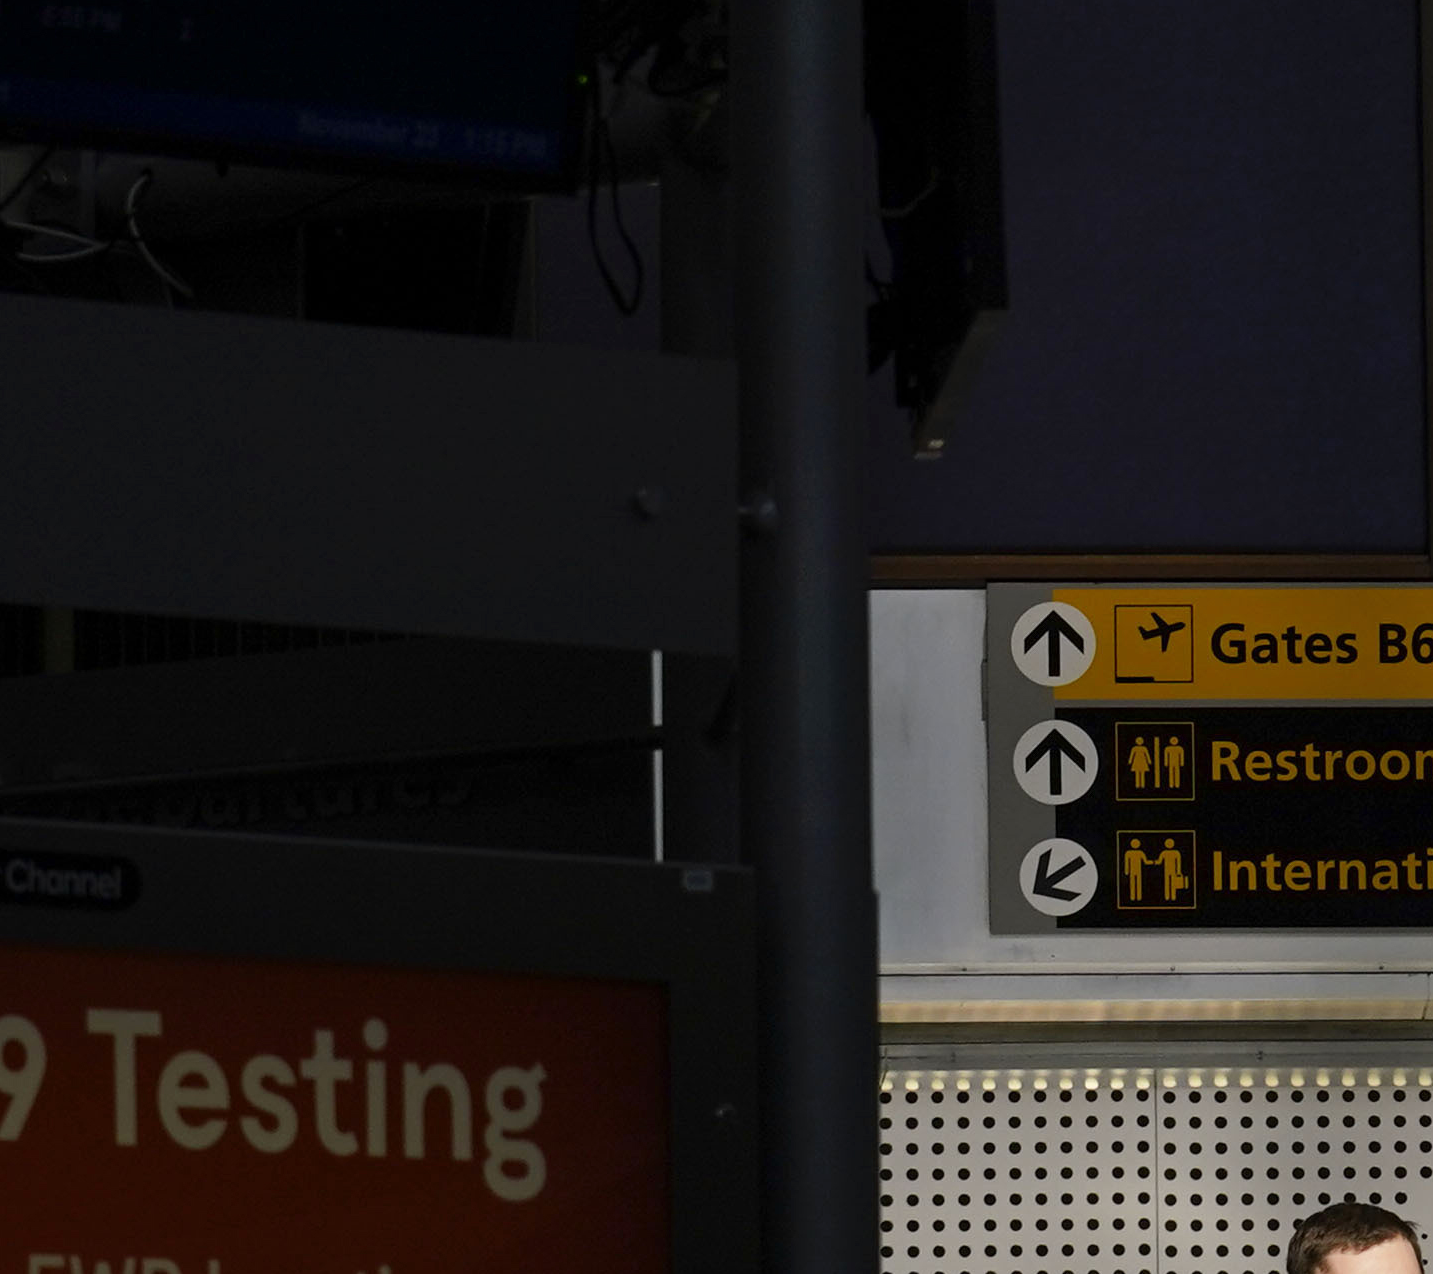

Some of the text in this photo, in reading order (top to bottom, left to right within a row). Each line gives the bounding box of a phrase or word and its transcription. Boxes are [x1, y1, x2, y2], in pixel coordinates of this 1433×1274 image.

[1211, 623, 1357, 664] Gates
[5, 858, 121, 899] Channel
[87, 1009, 546, 1201] Testing
